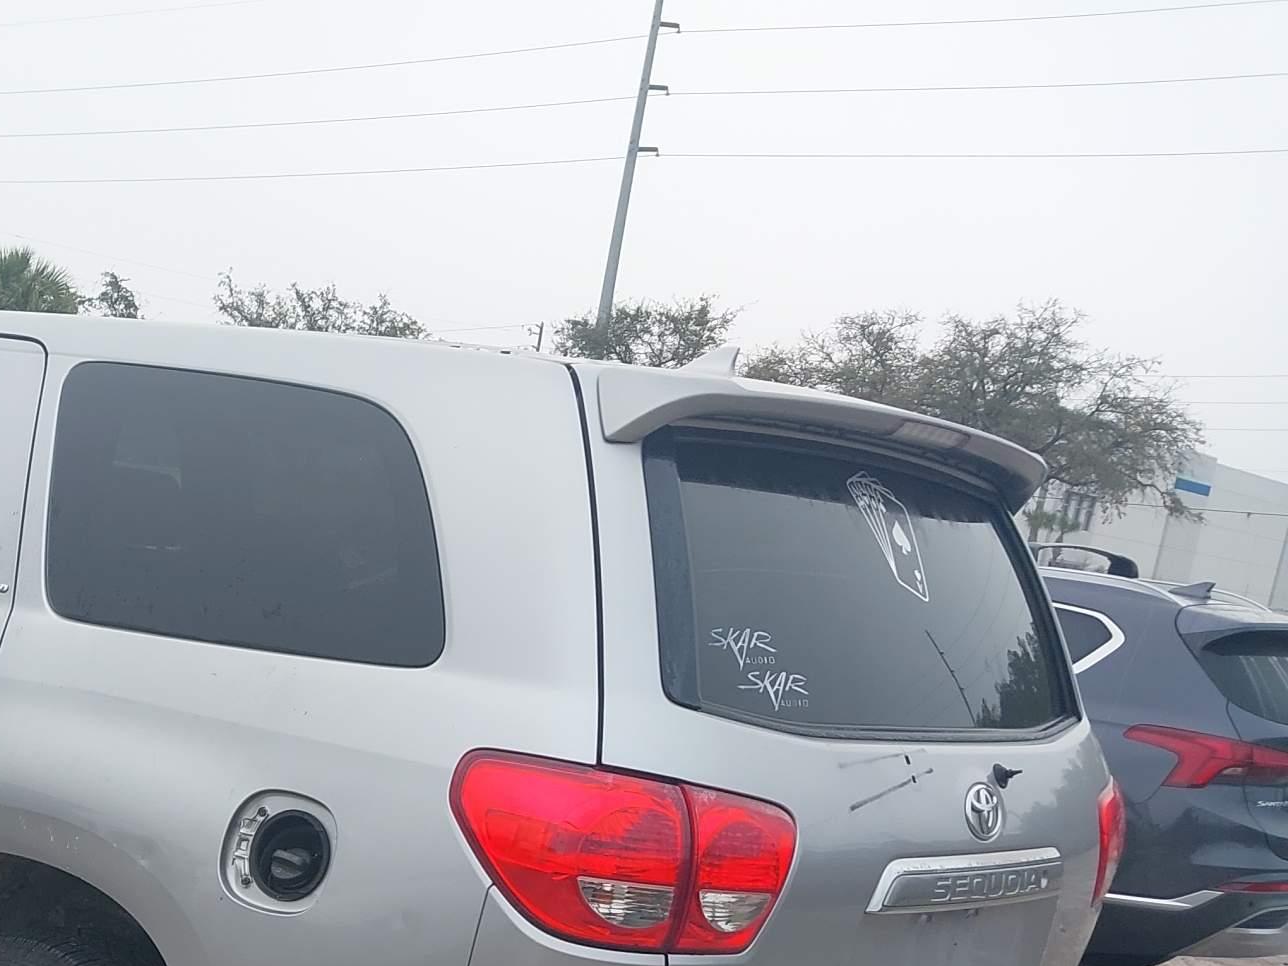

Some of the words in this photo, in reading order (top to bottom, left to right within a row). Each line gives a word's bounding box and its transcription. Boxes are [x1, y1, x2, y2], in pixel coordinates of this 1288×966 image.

[708, 627, 778, 671] SKAR
[745, 656, 776, 665] AUDIO
[737, 670, 809, 711] SKAR
[930, 871, 1040, 901] SEQUOIA
